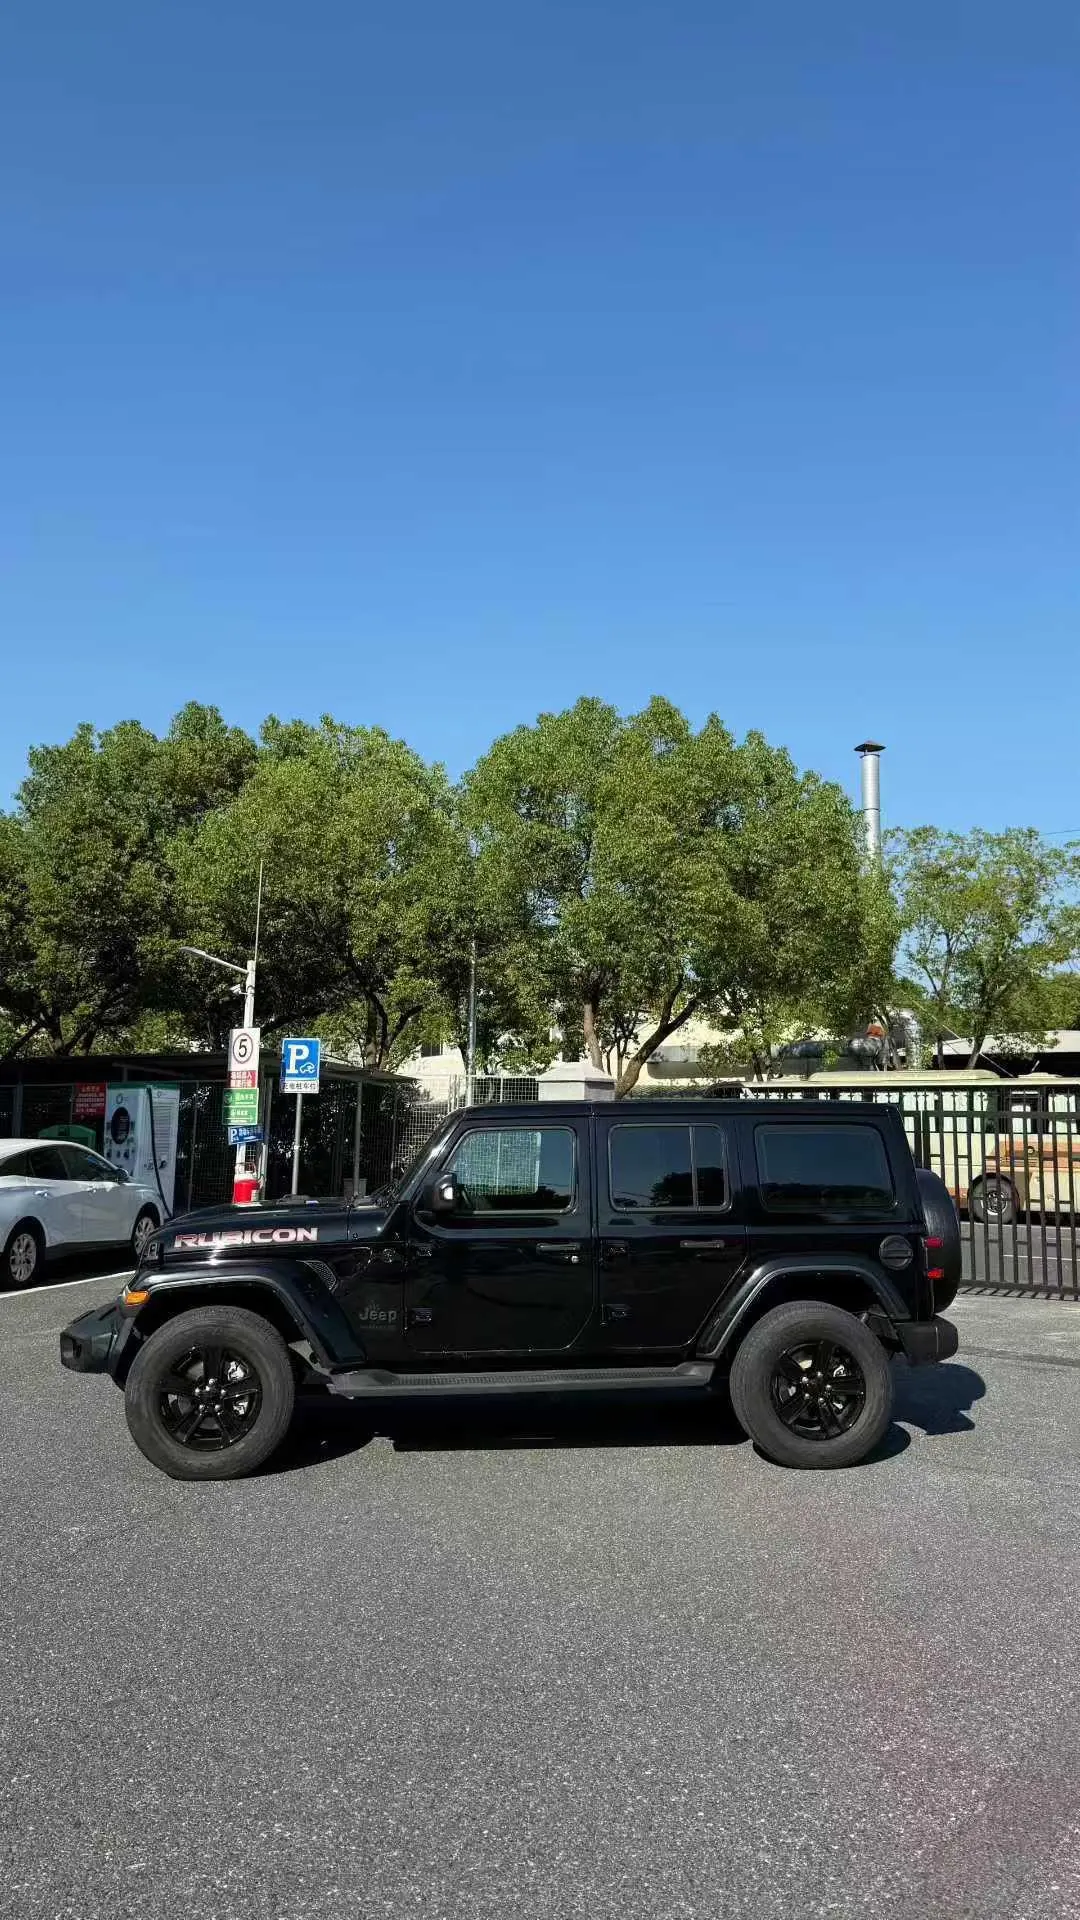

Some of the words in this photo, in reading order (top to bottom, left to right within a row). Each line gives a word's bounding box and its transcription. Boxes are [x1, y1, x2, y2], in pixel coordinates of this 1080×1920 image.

[238, 1038, 248, 1058] 5
[286, 1044, 310, 1074] P
[174, 1227, 318, 1248] RUBICON
[359, 1307, 397, 1324] Jeep
